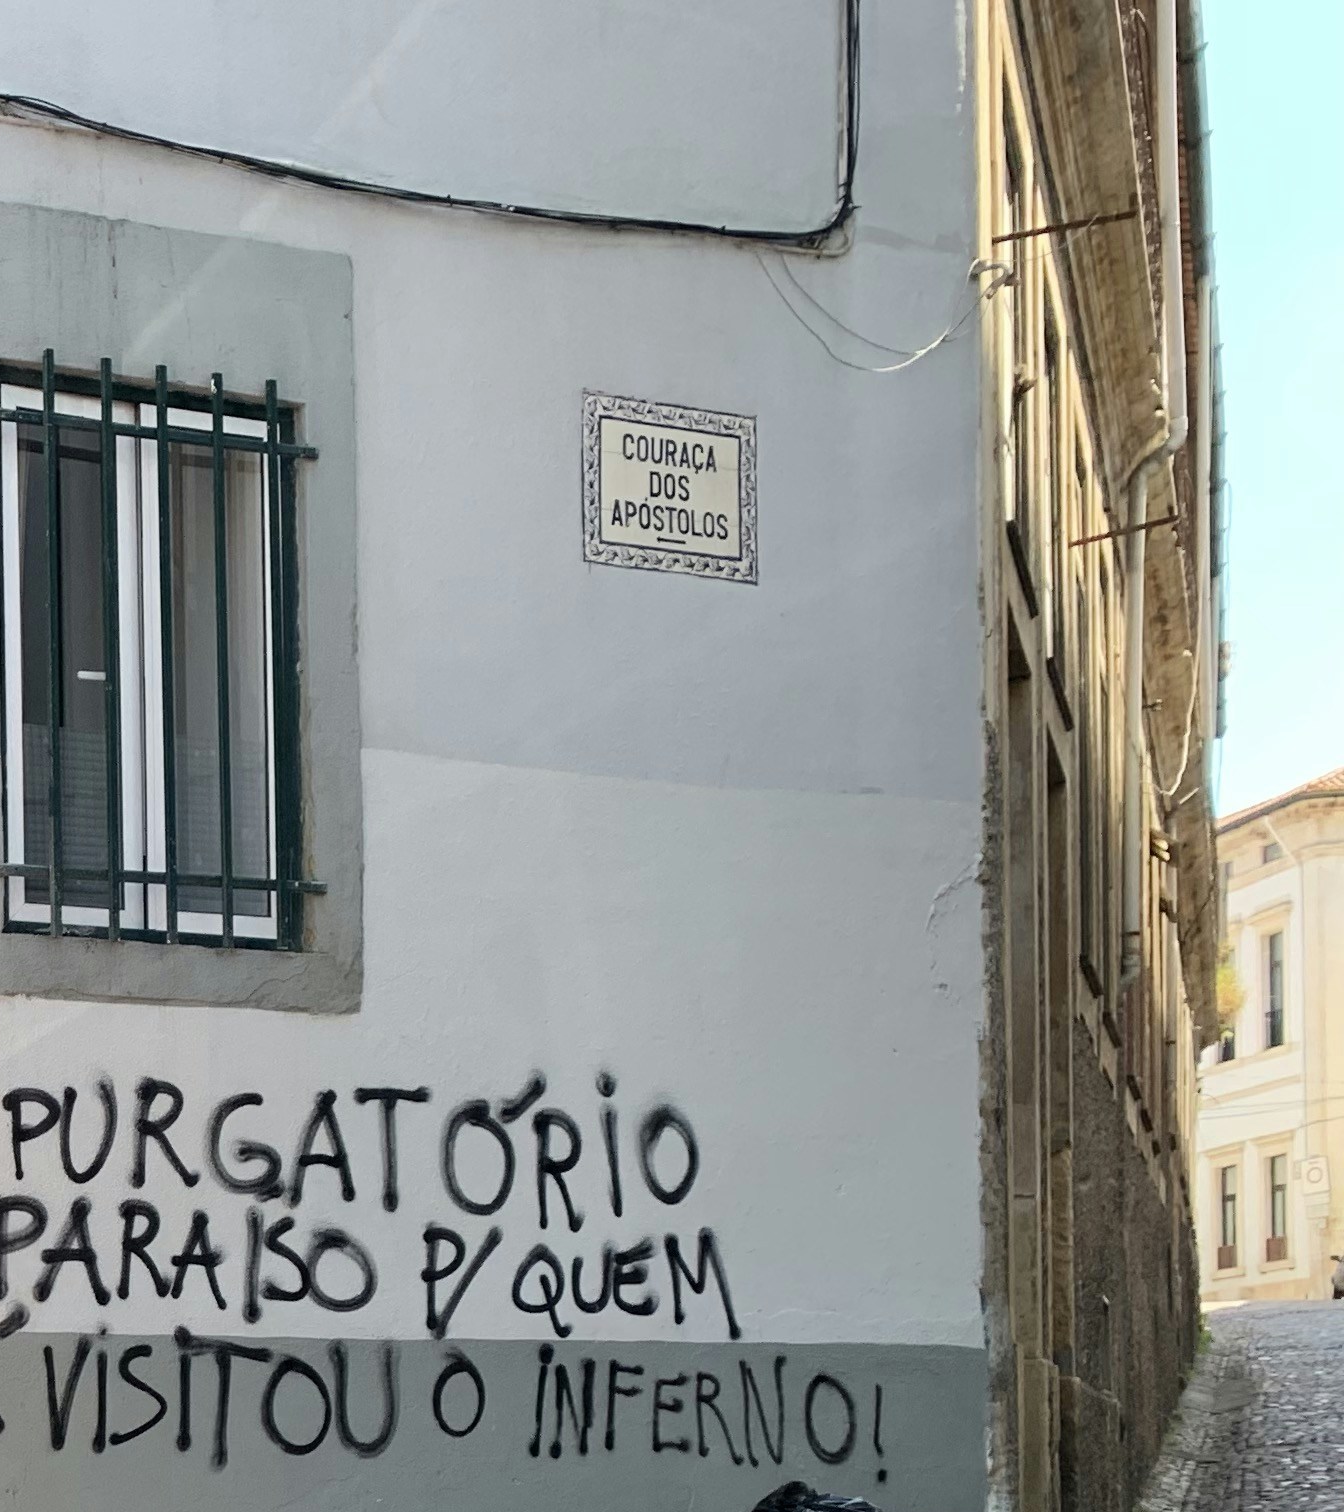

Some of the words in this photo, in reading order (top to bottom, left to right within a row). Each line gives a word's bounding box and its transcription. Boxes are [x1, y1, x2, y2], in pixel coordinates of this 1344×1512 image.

[622, 433, 718, 475] COURAÇA
[649, 471, 691, 502] DOS
[3, 1070, 700, 1232] PURGATÓRIO
[512, 1226, 741, 1339] QUEM
[43, 1326, 400, 1470] VISITOU
[432, 1347, 486, 1437] O
